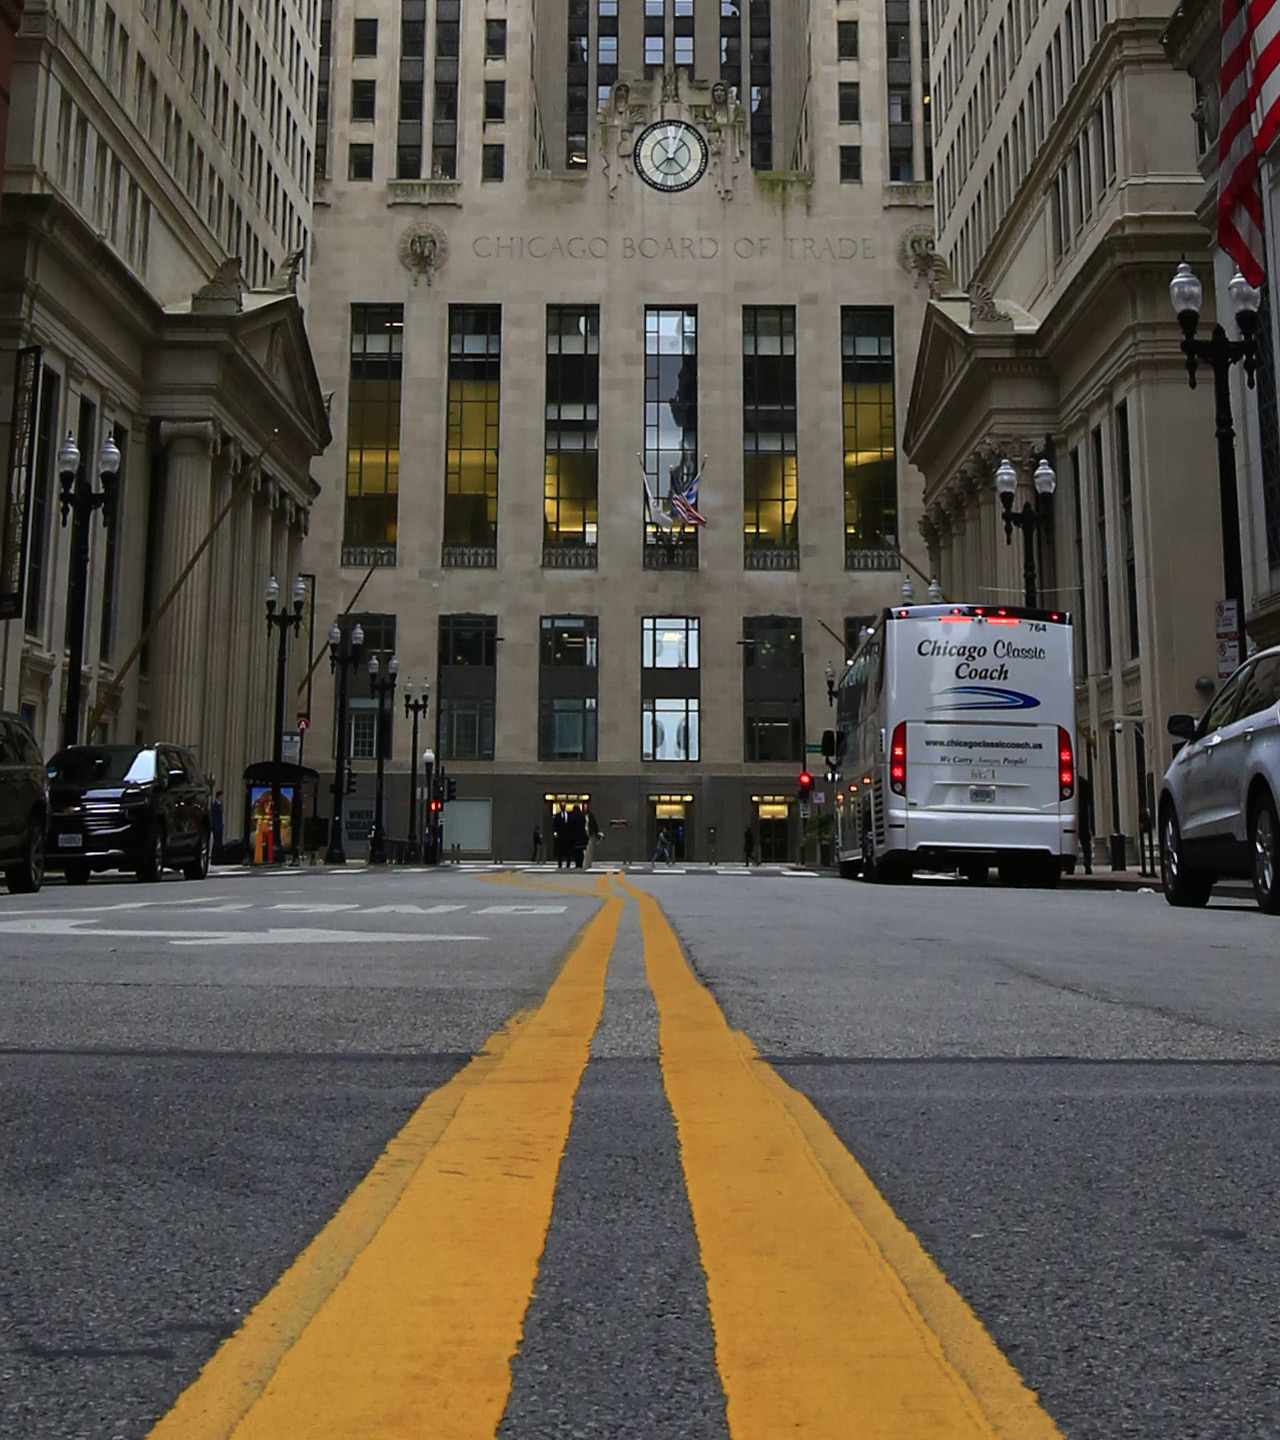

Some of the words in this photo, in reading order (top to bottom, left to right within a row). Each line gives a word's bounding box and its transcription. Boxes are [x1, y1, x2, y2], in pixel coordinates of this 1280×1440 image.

[472, 236, 608, 259] CHICAGO
[623, 237, 718, 259] BOARD
[734, 237, 770, 258] OF
[785, 237, 876, 259] TRADE
[1028, 623, 1047, 632] 764
[917, 639, 987, 661] Chicago
[993, 640, 1045, 659] Classic
[955, 663, 1008, 680] Coach
[925, 739, 1043, 749] www.chicagoclassiccoach.us
